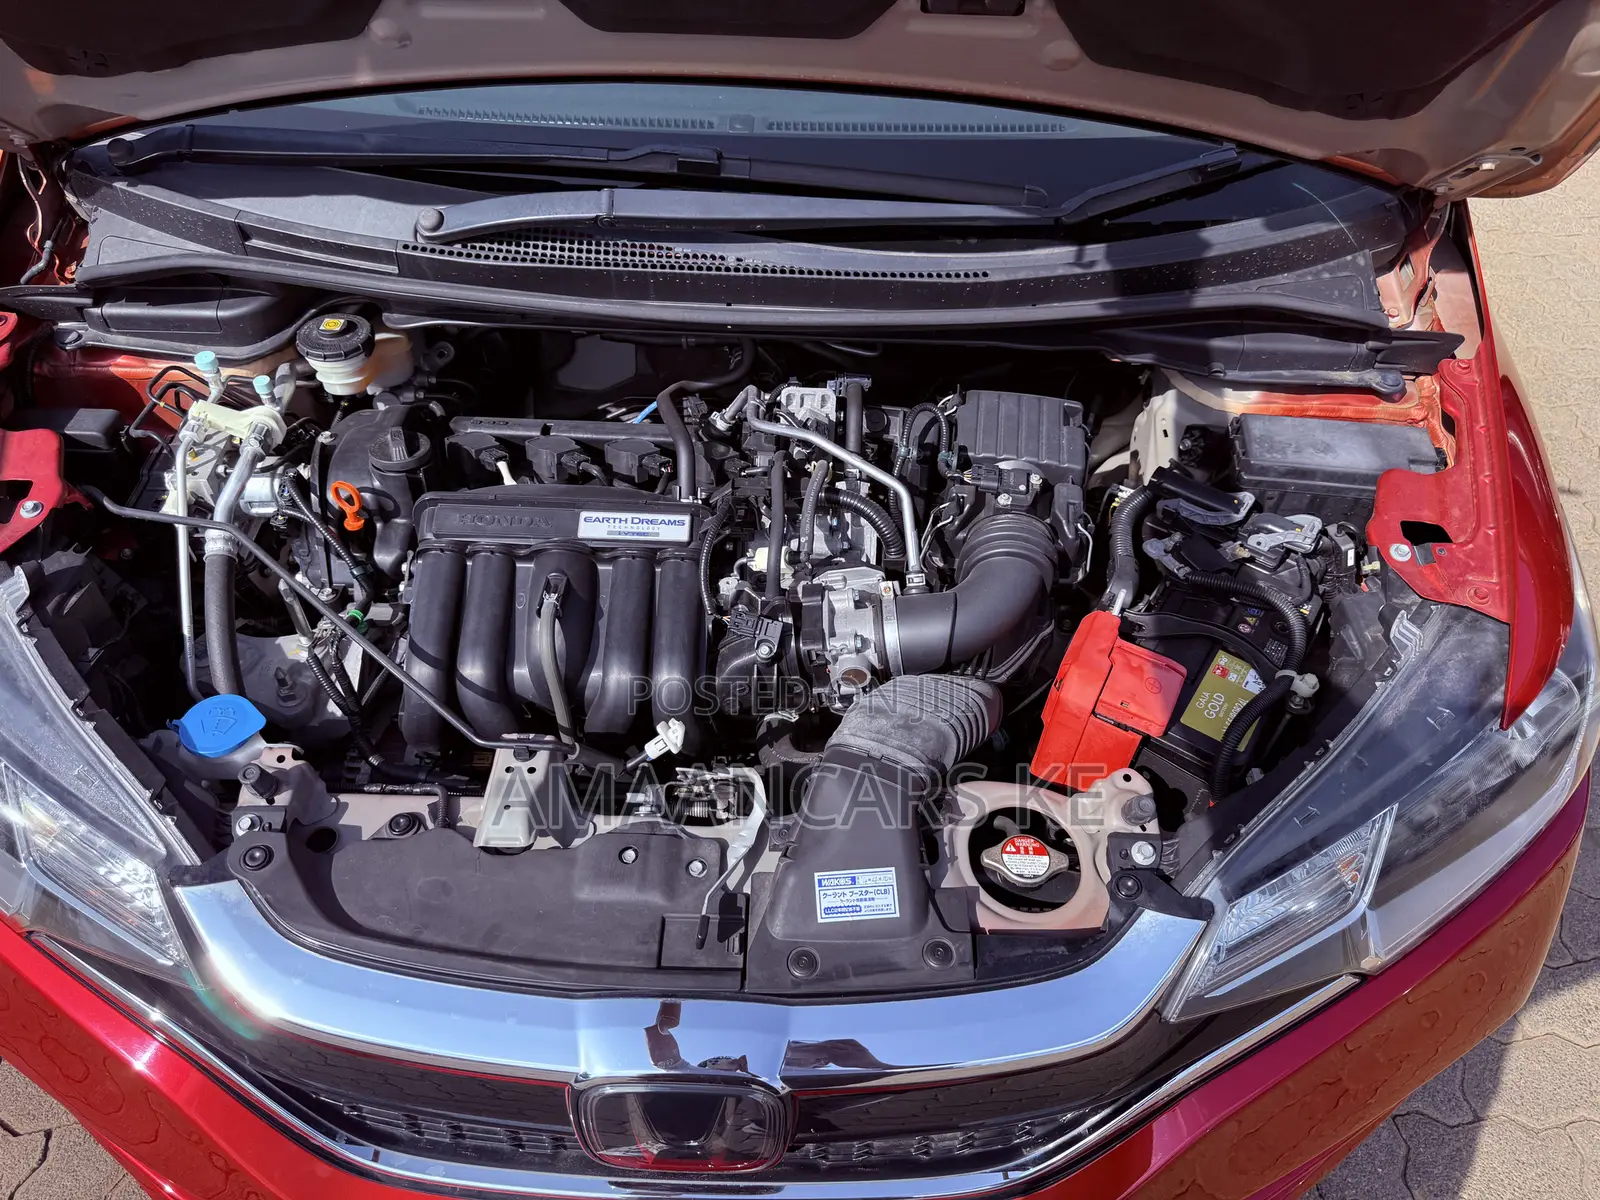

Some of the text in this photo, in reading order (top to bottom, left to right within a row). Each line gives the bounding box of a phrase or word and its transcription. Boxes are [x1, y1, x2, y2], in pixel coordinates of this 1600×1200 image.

[460, 512, 553, 528] HONDA
[583, 516, 686, 527] EARTH DREAMS
[1195, 691, 1211, 709] GAIA
[1204, 692, 1225, 719] GOLD
